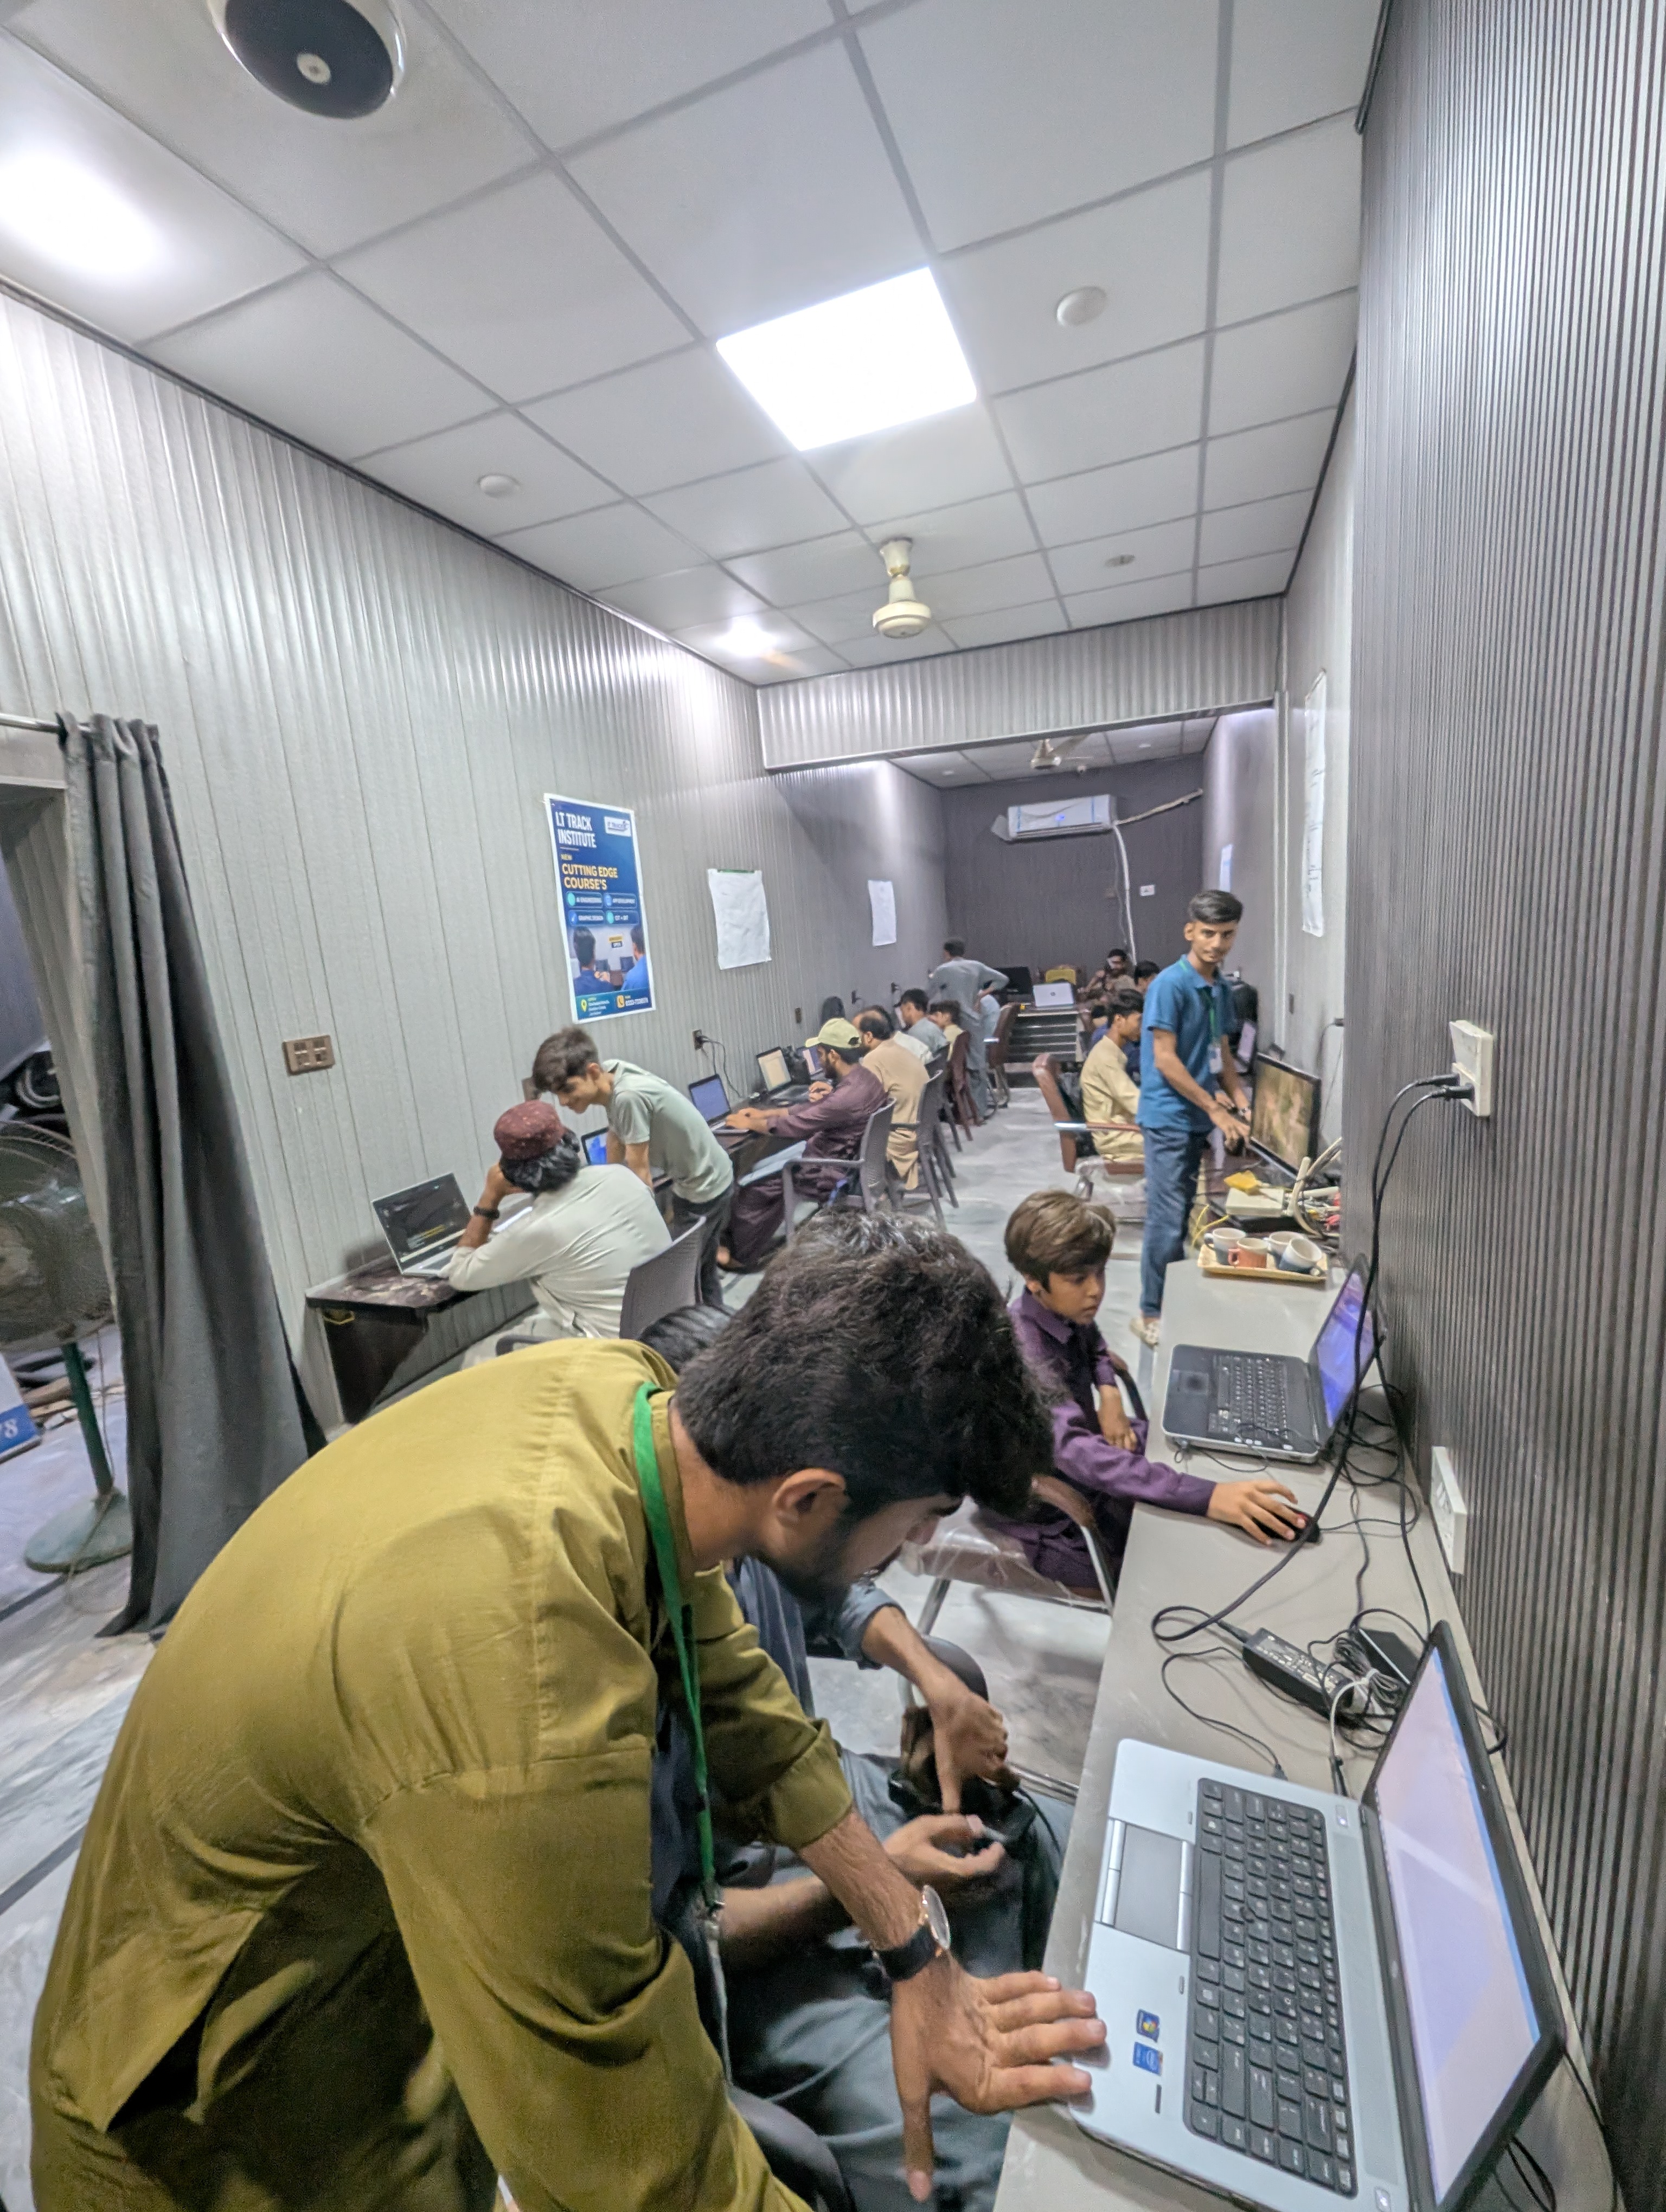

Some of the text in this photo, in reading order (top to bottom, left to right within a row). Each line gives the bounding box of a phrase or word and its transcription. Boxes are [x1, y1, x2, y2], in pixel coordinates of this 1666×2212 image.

[566, 813, 592, 831] TRACK
[558, 829, 597, 848] INSTITUTE
[562, 864, 618, 878] CUTTING EDGE
[564, 877, 607, 890] COURSE'S
